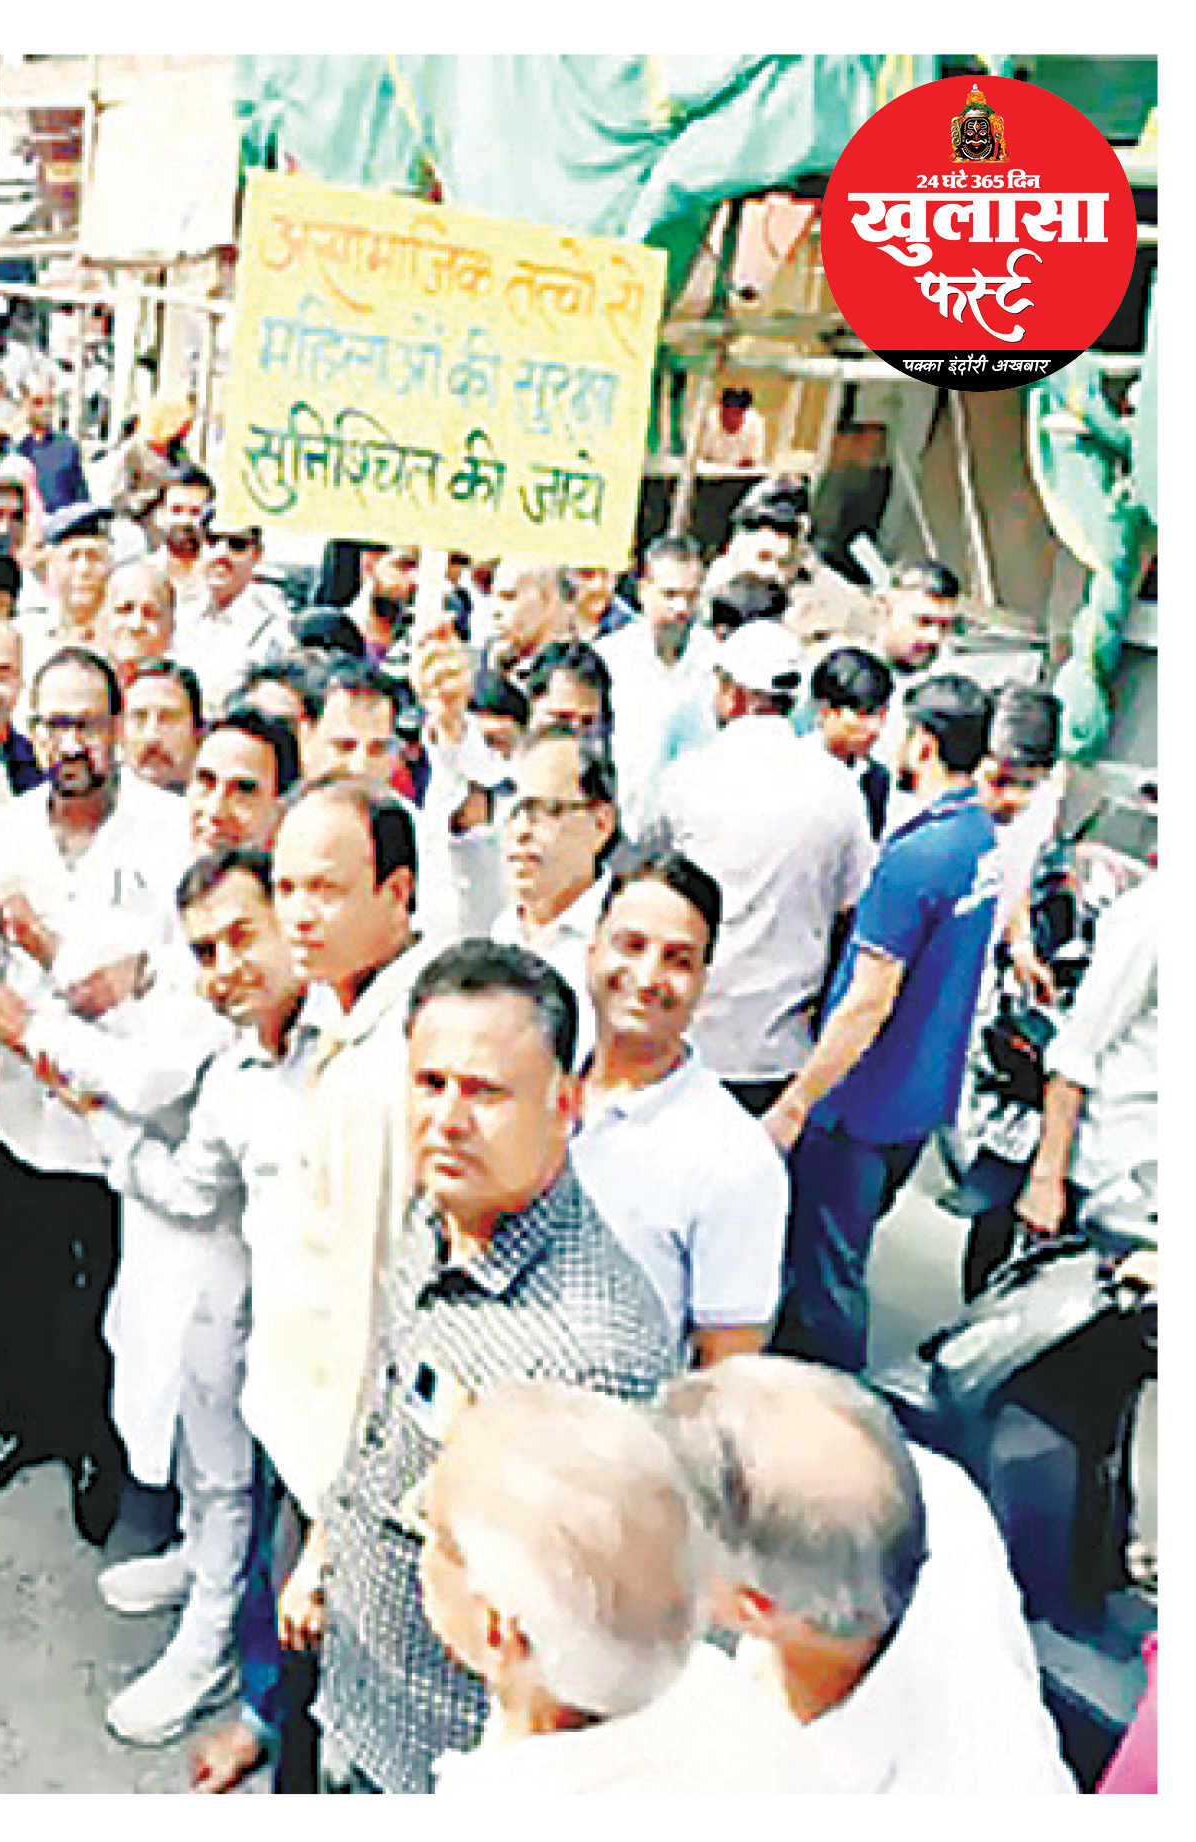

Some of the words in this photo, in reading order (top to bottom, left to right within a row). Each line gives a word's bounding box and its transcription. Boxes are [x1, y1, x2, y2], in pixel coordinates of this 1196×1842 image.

[604, 253, 646, 358] से
[447, 326, 502, 408] की
[446, 428, 507, 511] की
